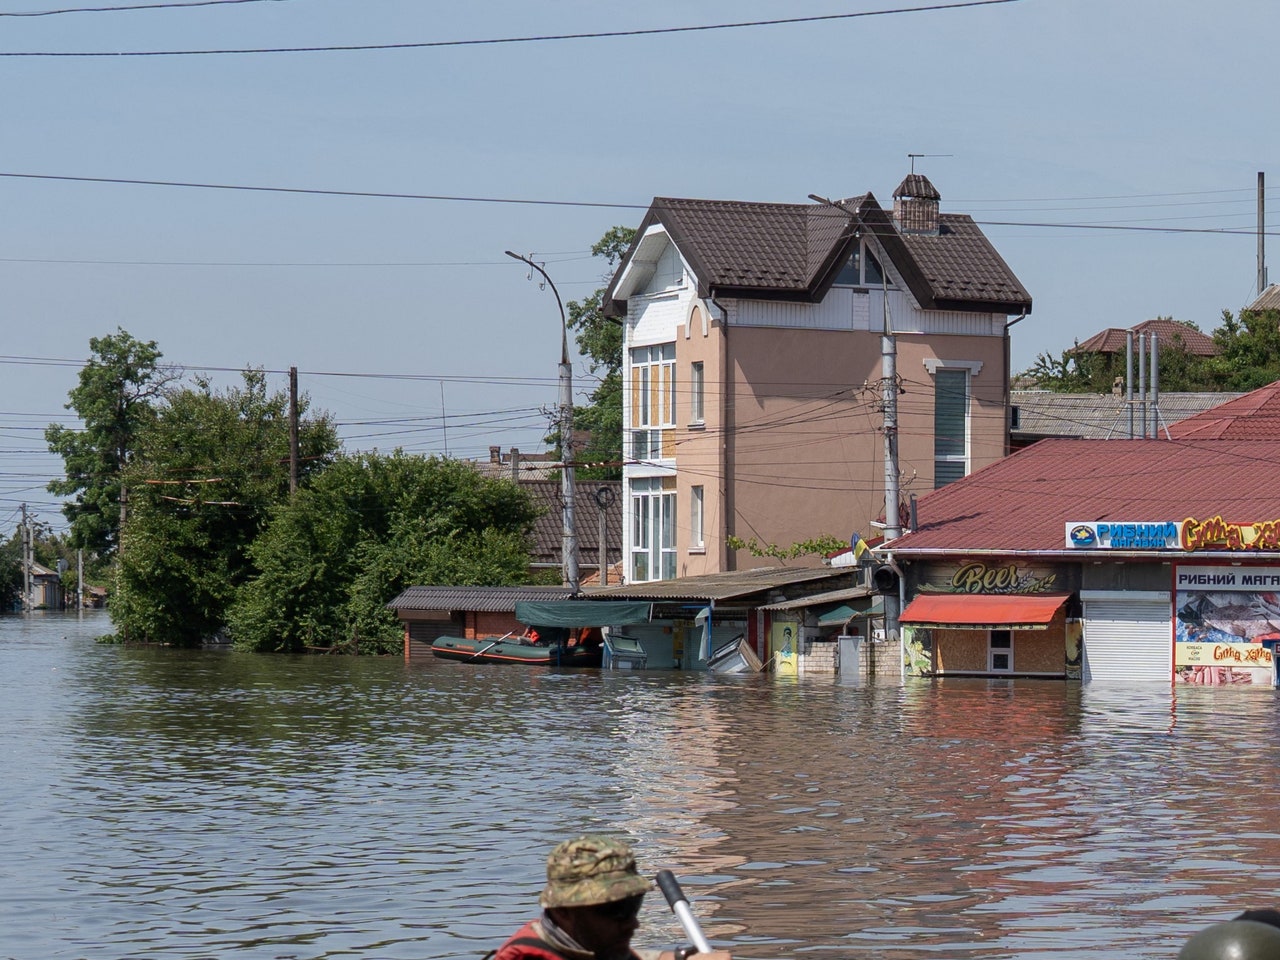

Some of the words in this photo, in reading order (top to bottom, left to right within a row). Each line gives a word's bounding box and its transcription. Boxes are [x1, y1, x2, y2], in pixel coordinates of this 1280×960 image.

[1097, 521, 1178, 540] РИБНИЙ
[952, 561, 1019, 593] Beer
[1179, 573, 1236, 585] РИБНИЙ
